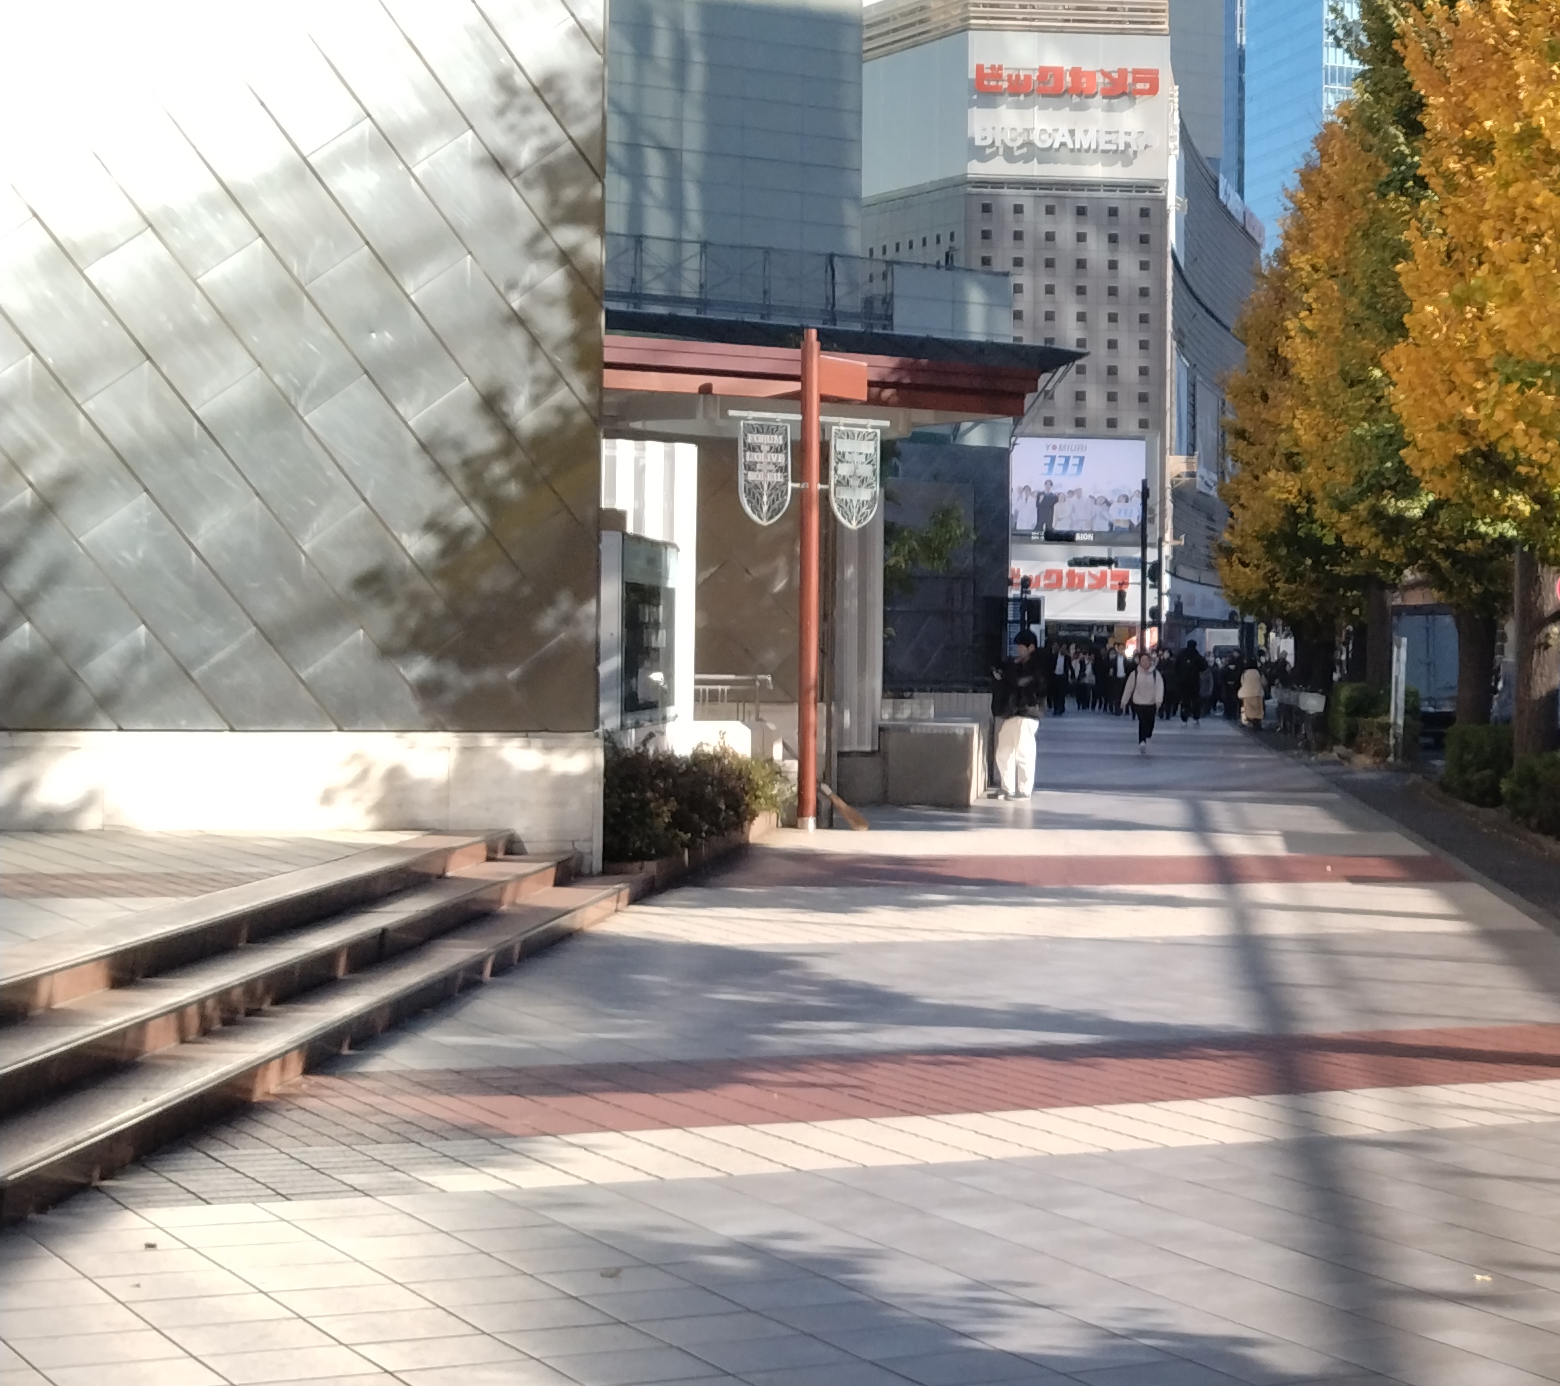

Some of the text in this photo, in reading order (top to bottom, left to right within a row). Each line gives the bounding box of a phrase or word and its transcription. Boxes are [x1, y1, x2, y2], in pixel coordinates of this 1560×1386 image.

[975, 64, 1160, 96] ビックカメラ
[974, 125, 1024, 147] BIC
[747, 434, 783, 444] FORUM
